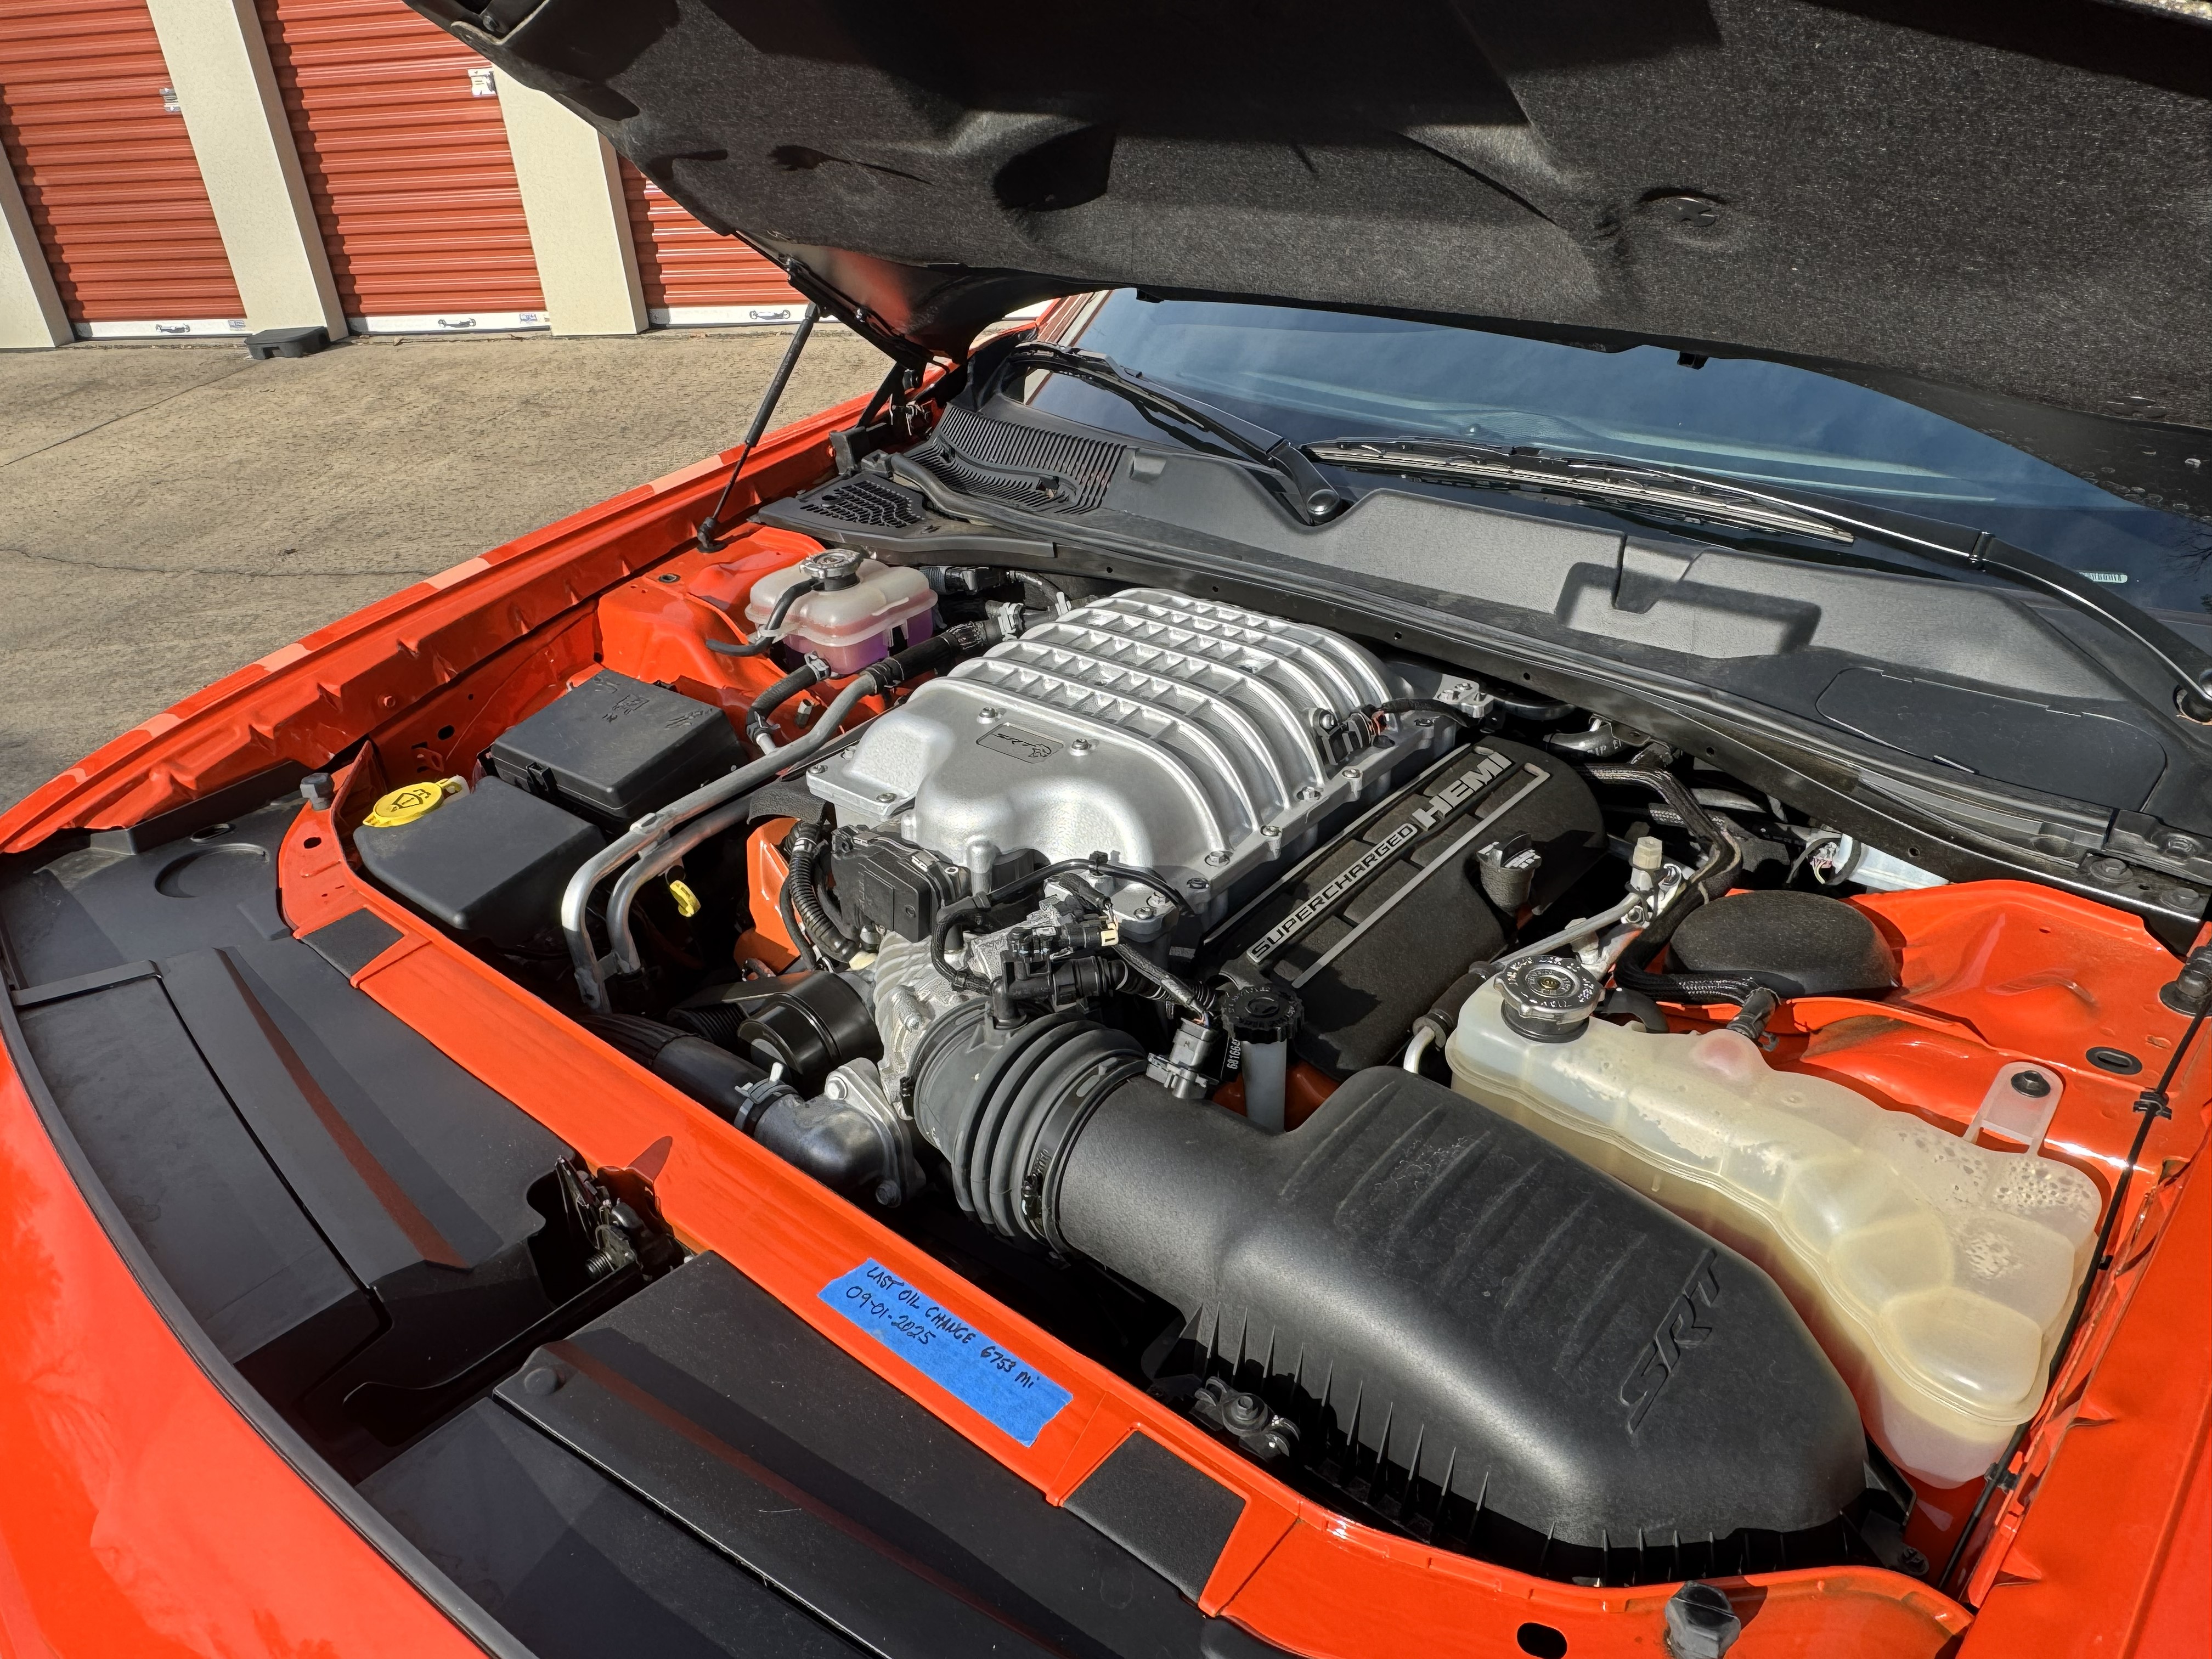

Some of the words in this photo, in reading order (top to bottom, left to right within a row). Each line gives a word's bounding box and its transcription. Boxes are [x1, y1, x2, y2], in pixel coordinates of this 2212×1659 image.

[1251, 826, 1415, 957] SUPERCHARGED
[1412, 752, 1514, 831] HEMI
[846, 1285, 936, 1345] 09-01-2025
[867, 1266, 904, 1290] LAST
[898, 1290, 920, 1309] OIL
[926, 1306, 977, 1344] CHANGE
[980, 1346, 1017, 1373] 6753
[1620, 1248, 1720, 1434] SRT
